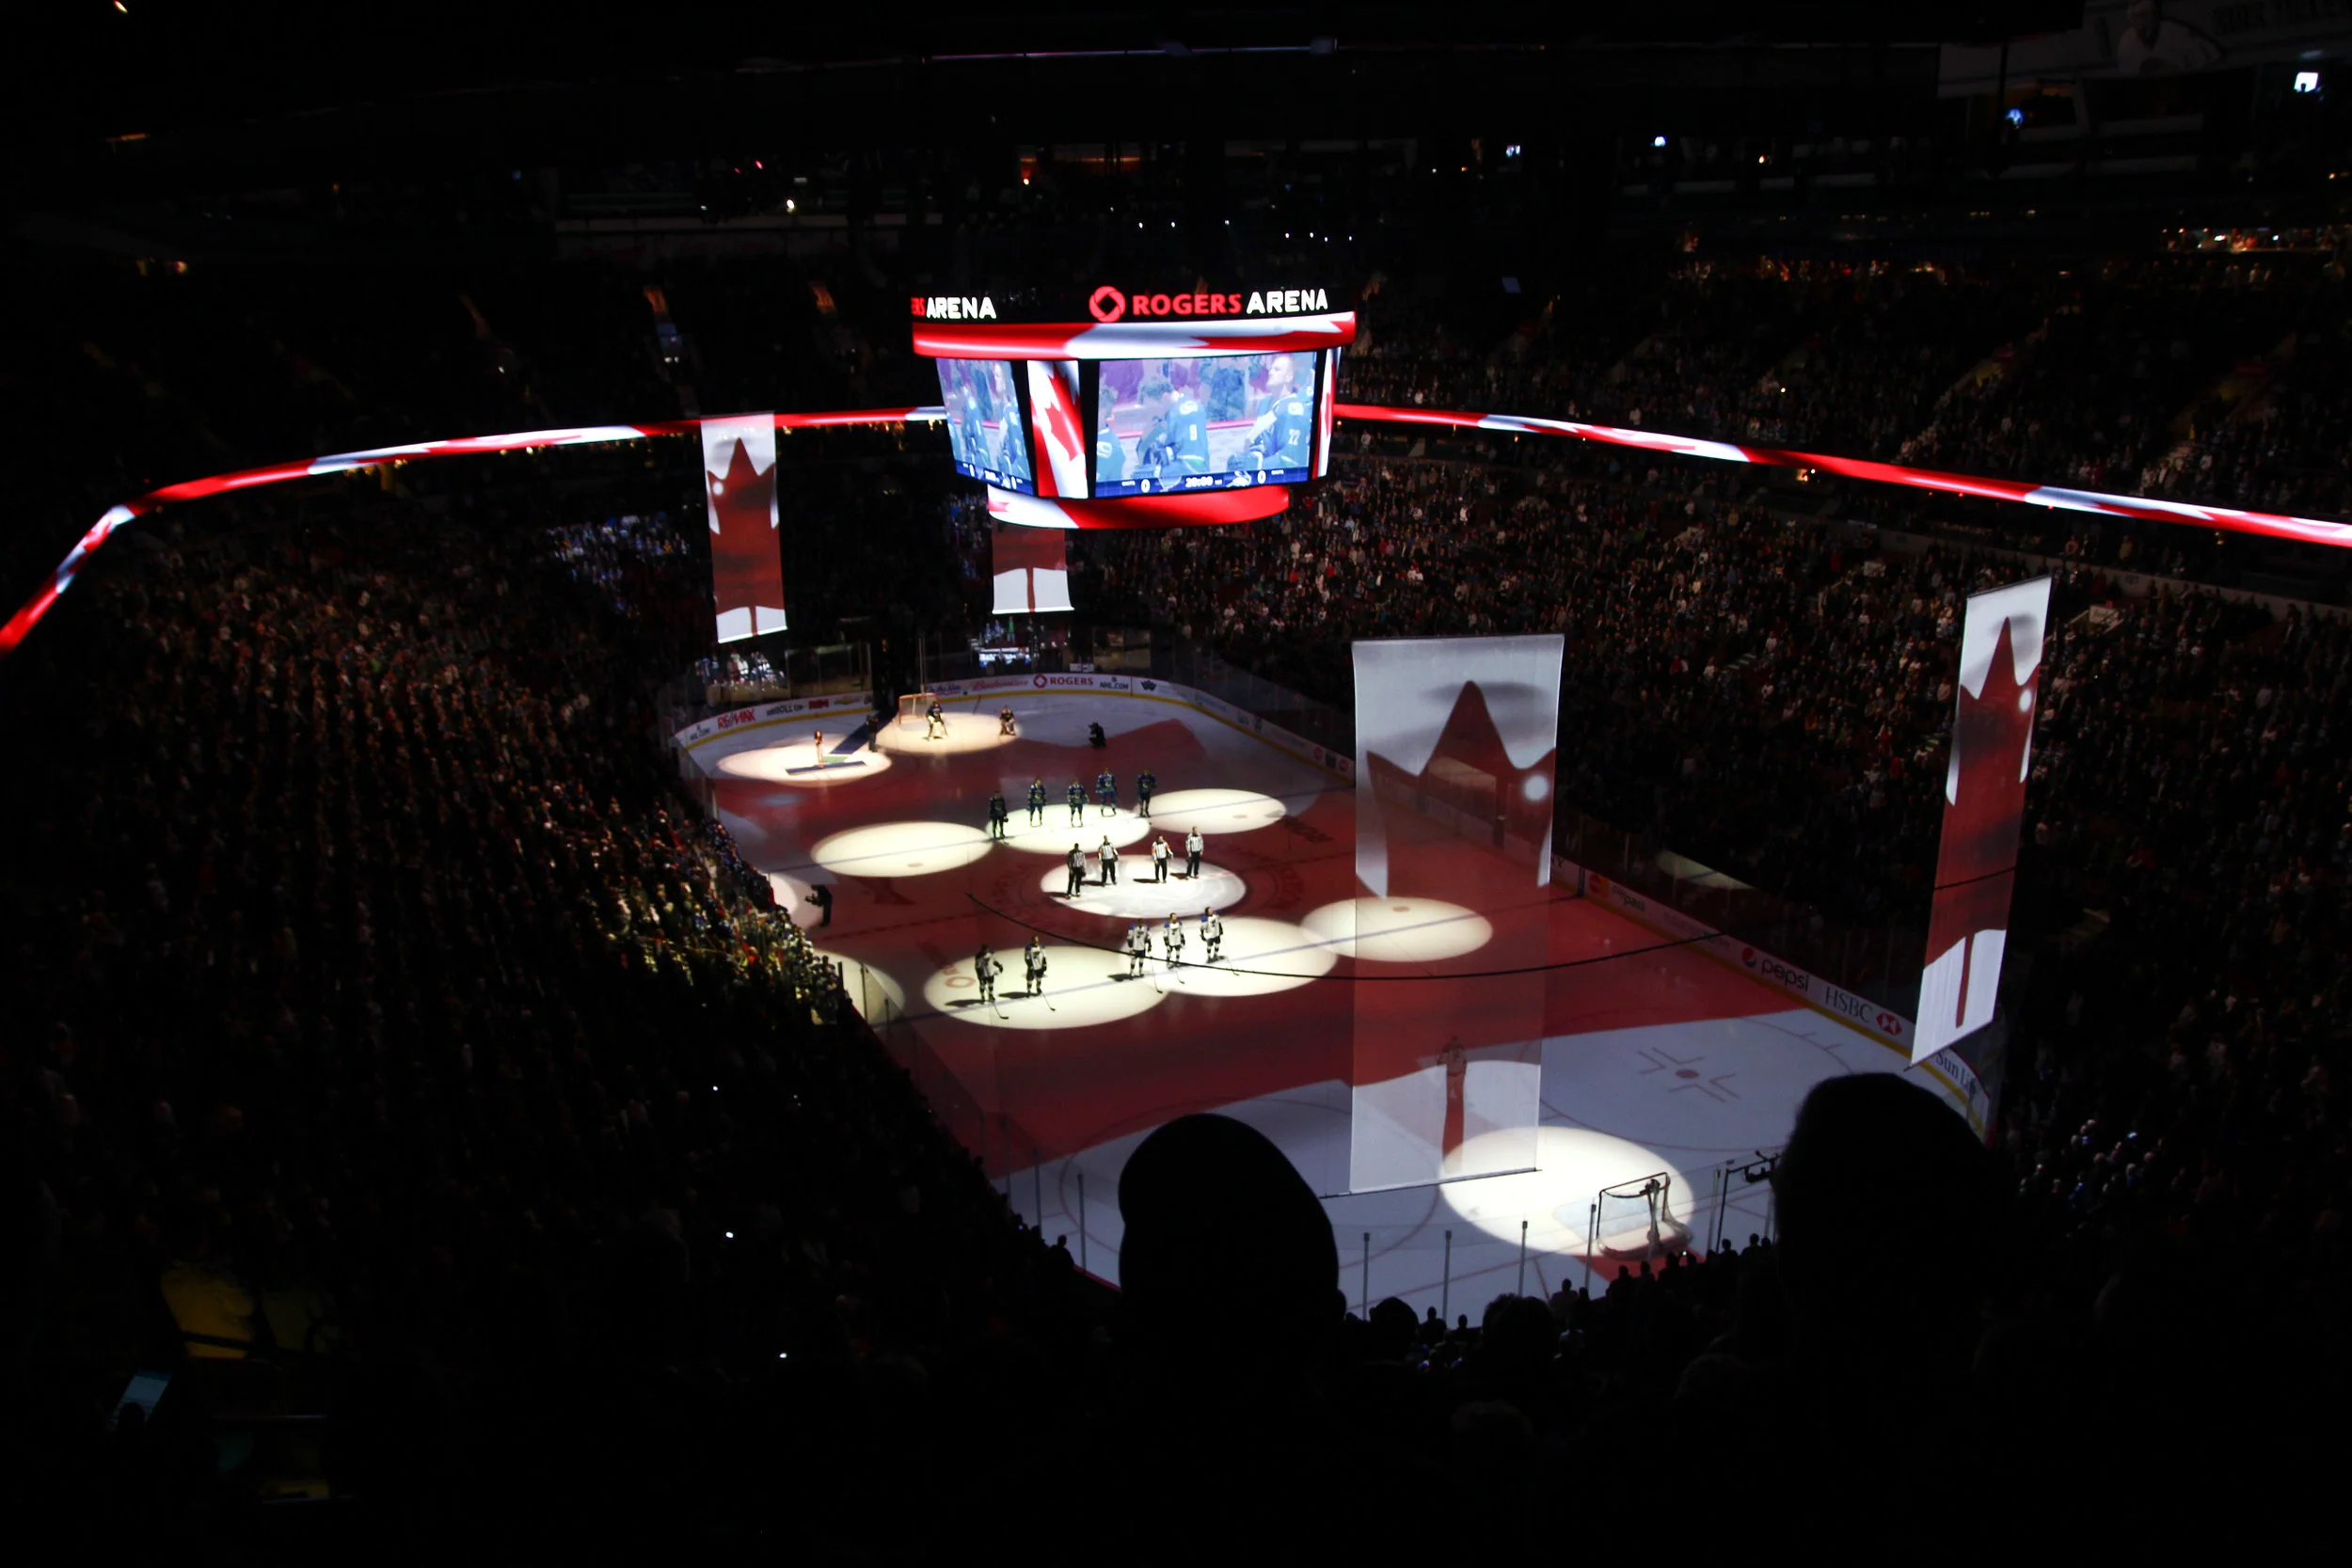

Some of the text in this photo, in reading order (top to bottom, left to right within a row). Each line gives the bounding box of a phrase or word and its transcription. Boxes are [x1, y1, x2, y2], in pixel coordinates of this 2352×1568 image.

[926, 296, 997, 320] ARENA
[1132, 288, 1328, 316] ROGERS ARENA
[1050, 676, 1094, 686] ROGERS
[717, 708, 756, 730] RE/MAX
[1761, 958, 1810, 991] pepsi
[1825, 986, 1874, 1023] HSBC
[1935, 1051, 1959, 1079] Sun
